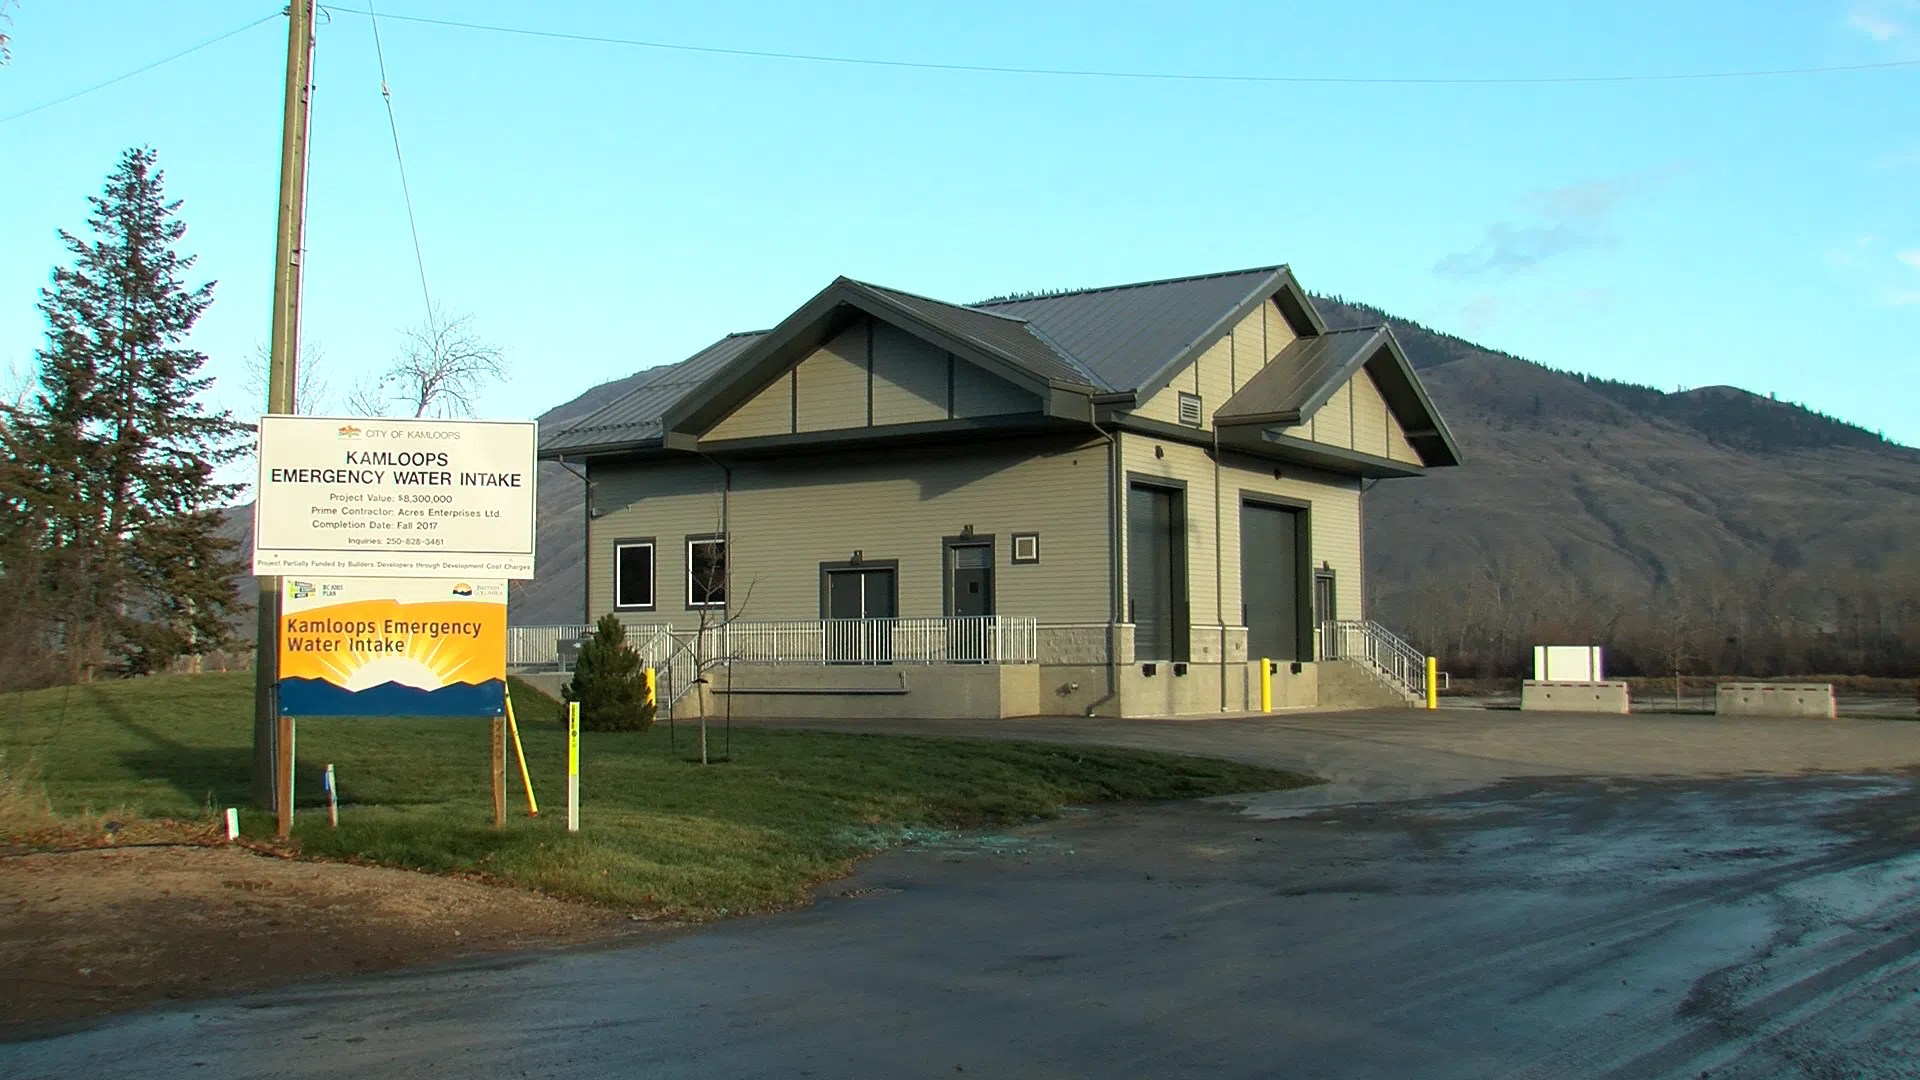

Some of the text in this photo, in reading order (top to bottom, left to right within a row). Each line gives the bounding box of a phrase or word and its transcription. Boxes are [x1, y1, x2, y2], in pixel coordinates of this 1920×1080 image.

[365, 429, 461, 440] CITY OF KAMLOOPS
[346, 451, 448, 467] KAMLOOPS
[271, 469, 522, 487] EMERGENCY WATER INTAKE
[330, 493, 453, 504] Project Value: $8,300,000
[311, 506, 503, 518] Prime Contractor: Acres Enterprises Ltd.
[312, 520, 438, 530] Completion Date: Fall 2017
[386, 537, 444, 545] 250-828-3461
[443, 562, 484, 570] Development
[504, 563, 531, 571] Charges
[287, 618, 482, 638] Kamloops Emergency
[288, 637, 405, 652] Water Intake
